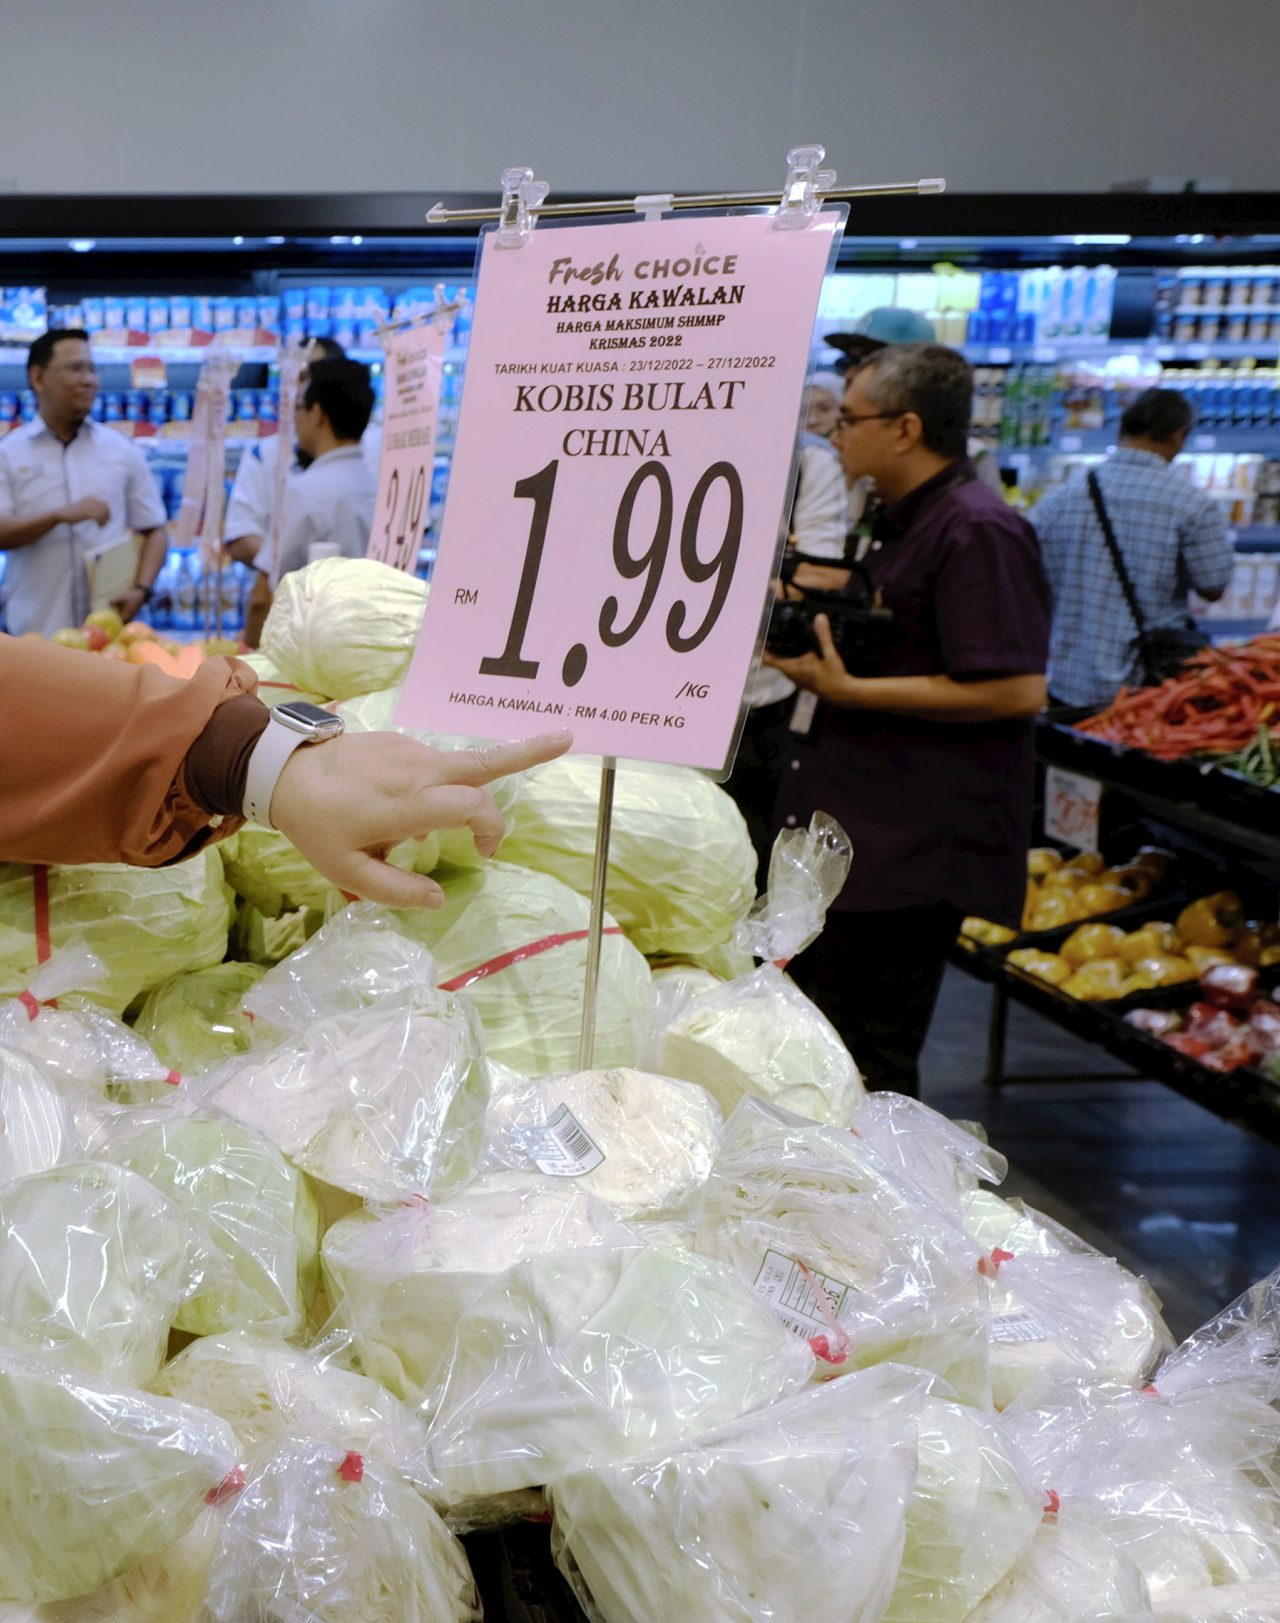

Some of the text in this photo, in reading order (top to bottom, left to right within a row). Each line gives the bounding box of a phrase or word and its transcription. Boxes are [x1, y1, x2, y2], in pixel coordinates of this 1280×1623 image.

[548, 253, 738, 286] Fresh CHOICE
[546, 284, 746, 314] HARGA KAWALAN
[556, 314, 726, 334] HARGA MAKSIMUM SHMMP
[589, 335, 683, 350] KRISMAS 2022
[494, 363, 538, 375] TARIKH
[540, 362, 573, 374] KUAT
[576, 361, 619, 373] KUASA
[629, 358, 694, 373] 23/12/2022
[707, 355, 777, 370] 27/12/2022
[513, 379, 746, 413] KOBIS BULAT
[562, 428, 673, 458] CHINA
[478, 459, 745, 689] 1.99
[454, 588, 479, 607] RM
[675, 681, 710, 699] /KG
[449, 691, 494, 707] HARGA
[497, 697, 564, 716] KAWALAN
[575, 705, 597, 719] RM
[599, 708, 628, 723] 4.00
[630, 711, 660, 726] PER
[663, 715, 686, 729] KG
